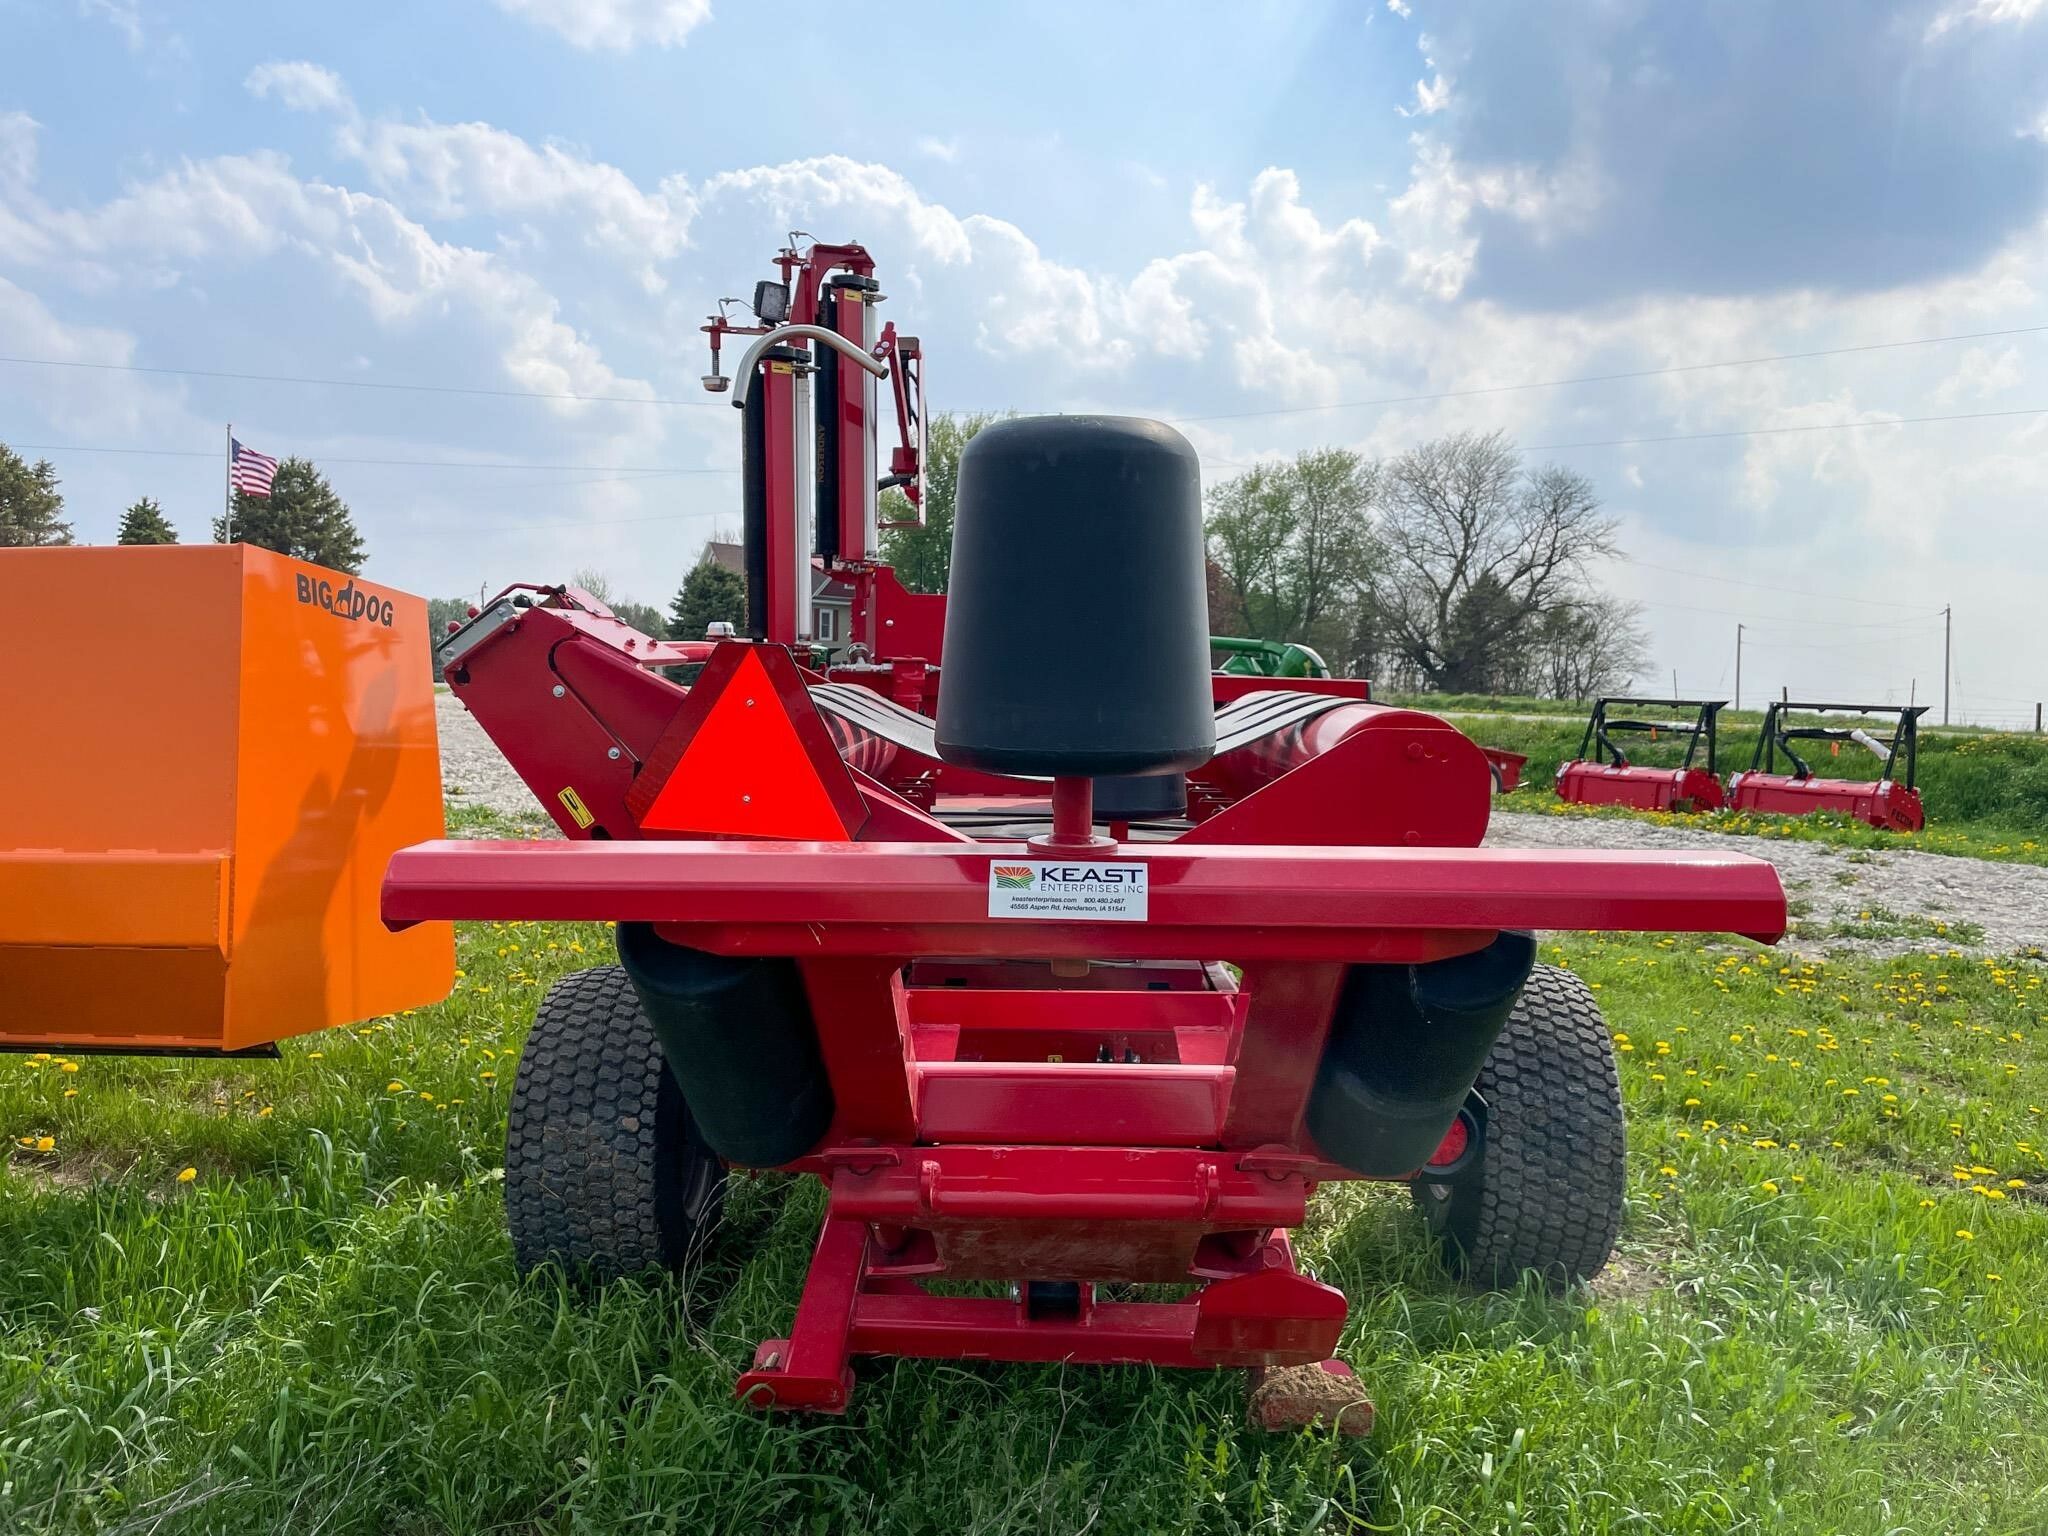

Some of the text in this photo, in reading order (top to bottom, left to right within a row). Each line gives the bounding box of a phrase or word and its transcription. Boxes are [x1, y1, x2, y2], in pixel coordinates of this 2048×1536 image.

[817, 424, 825, 483] ANDERSON
[296, 573, 393, 627] BIG DOG
[1040, 883, 1144, 894] ENTERPRISES INC
[1041, 867, 1143, 883] KEAST
